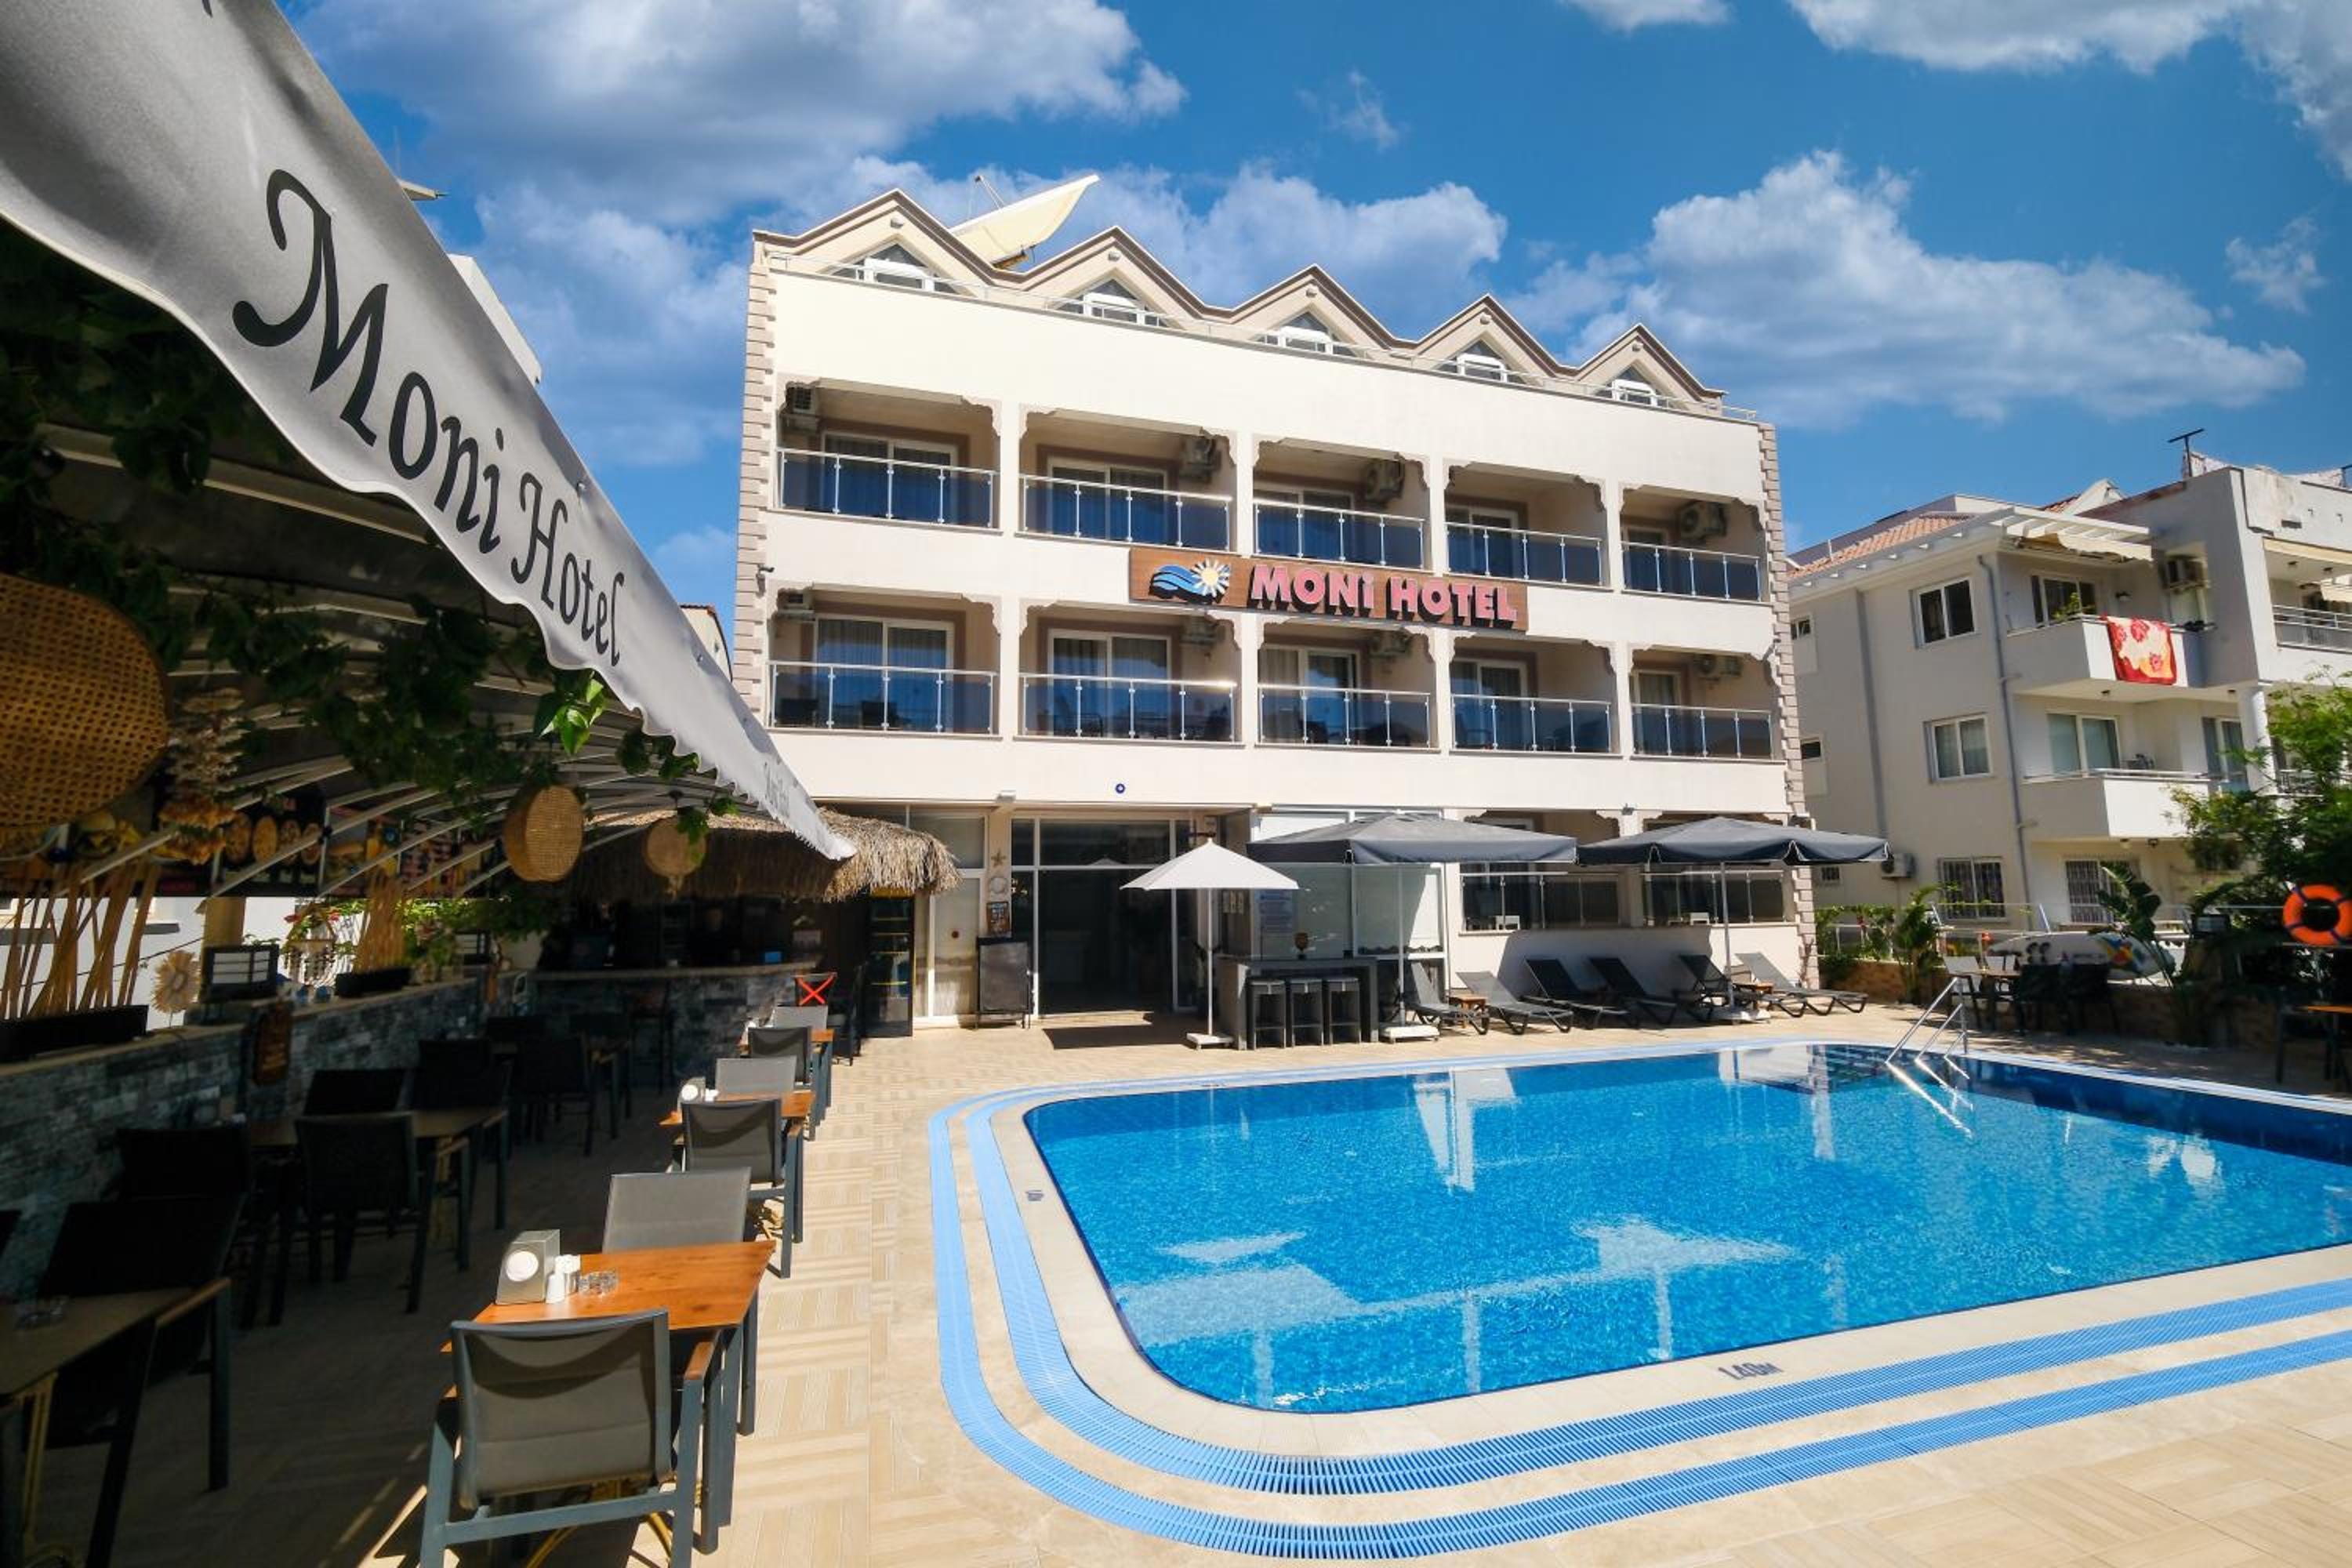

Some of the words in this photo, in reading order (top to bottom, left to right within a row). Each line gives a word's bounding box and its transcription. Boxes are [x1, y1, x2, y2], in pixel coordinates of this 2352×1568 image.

[232, 169, 502, 555] Moni
[510, 472, 626, 668] Hotel
[1389, 575, 1518, 622] HOTEL
